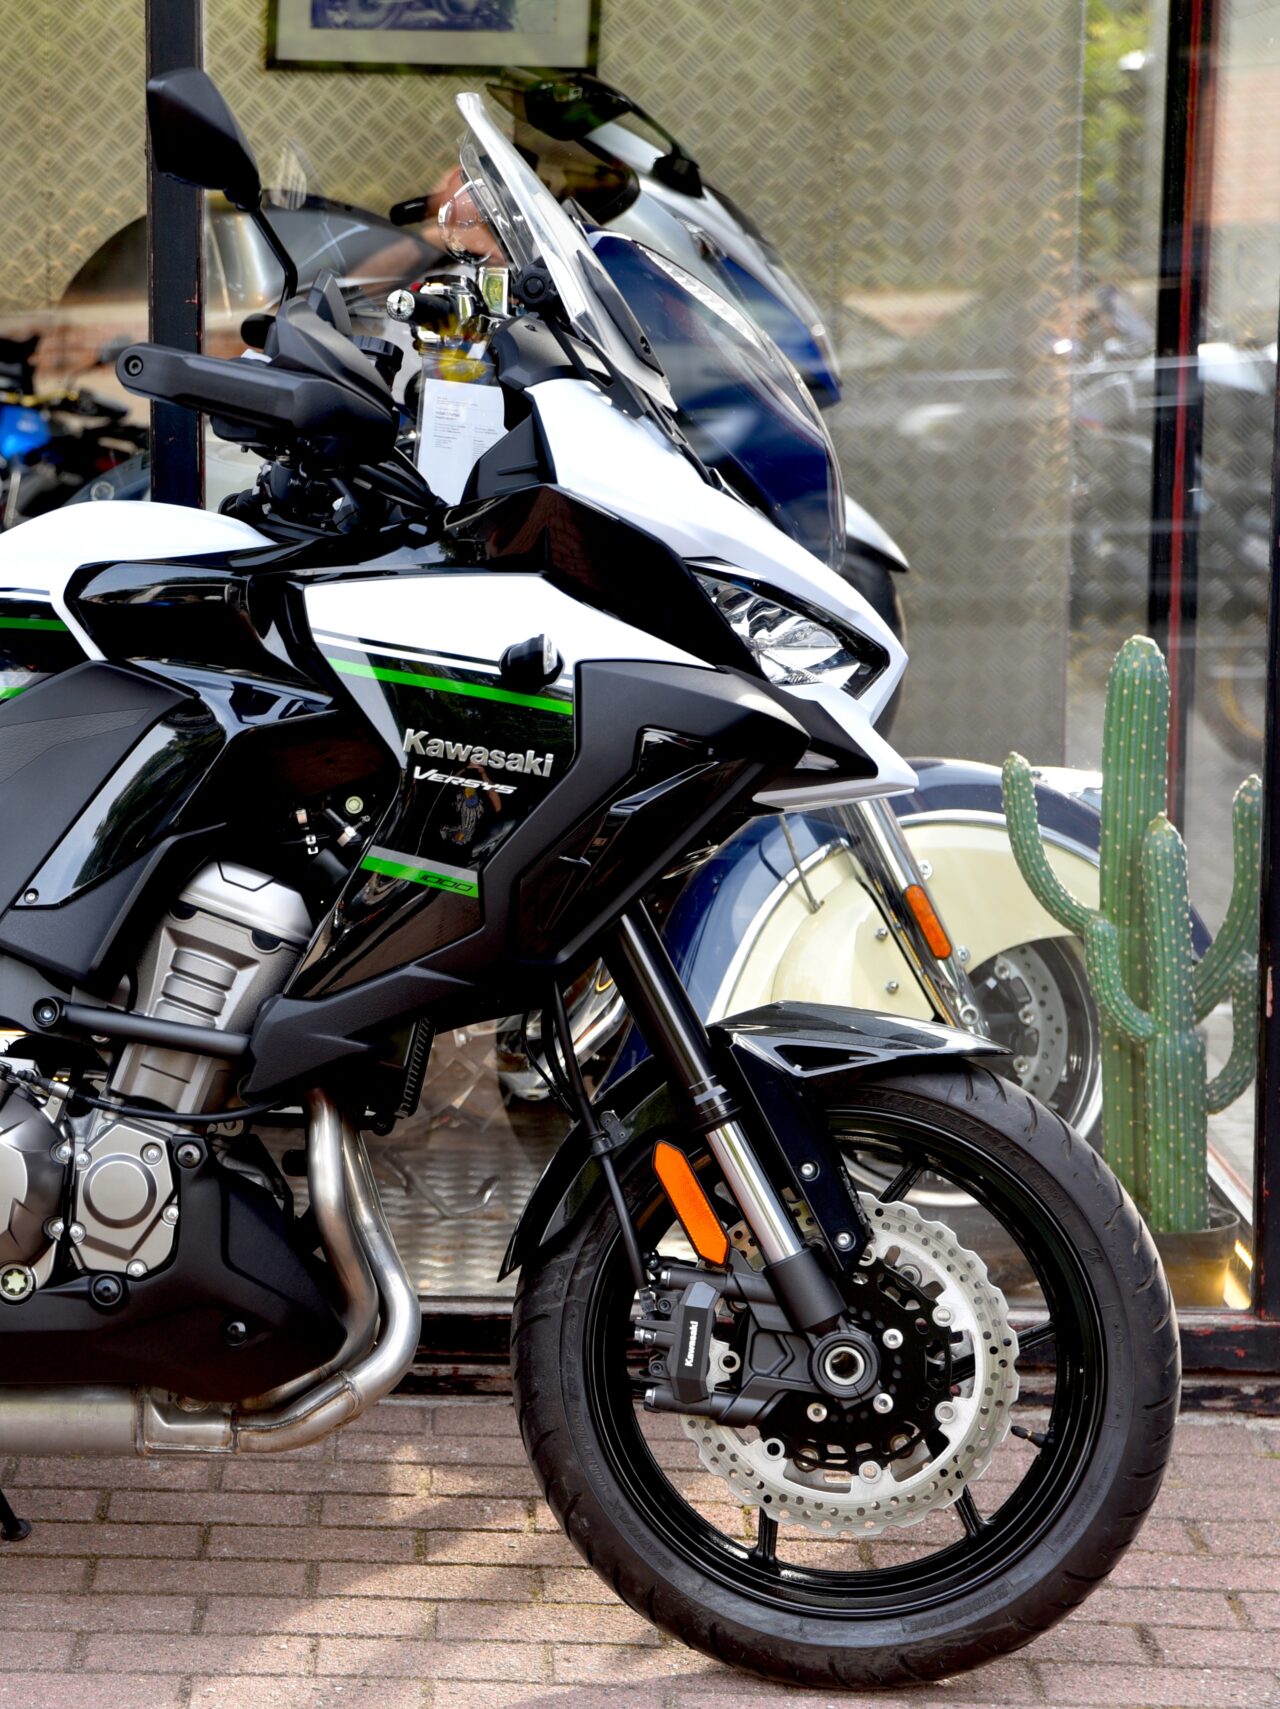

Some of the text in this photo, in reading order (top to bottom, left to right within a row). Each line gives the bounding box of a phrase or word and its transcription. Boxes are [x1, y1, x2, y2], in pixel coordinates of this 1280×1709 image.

[403, 728, 554, 777] Kawasaki
[413, 765, 517, 794] VERSYS
[420, 874, 474, 892] 1000
[684, 1320, 699, 1367] Kawasaki
